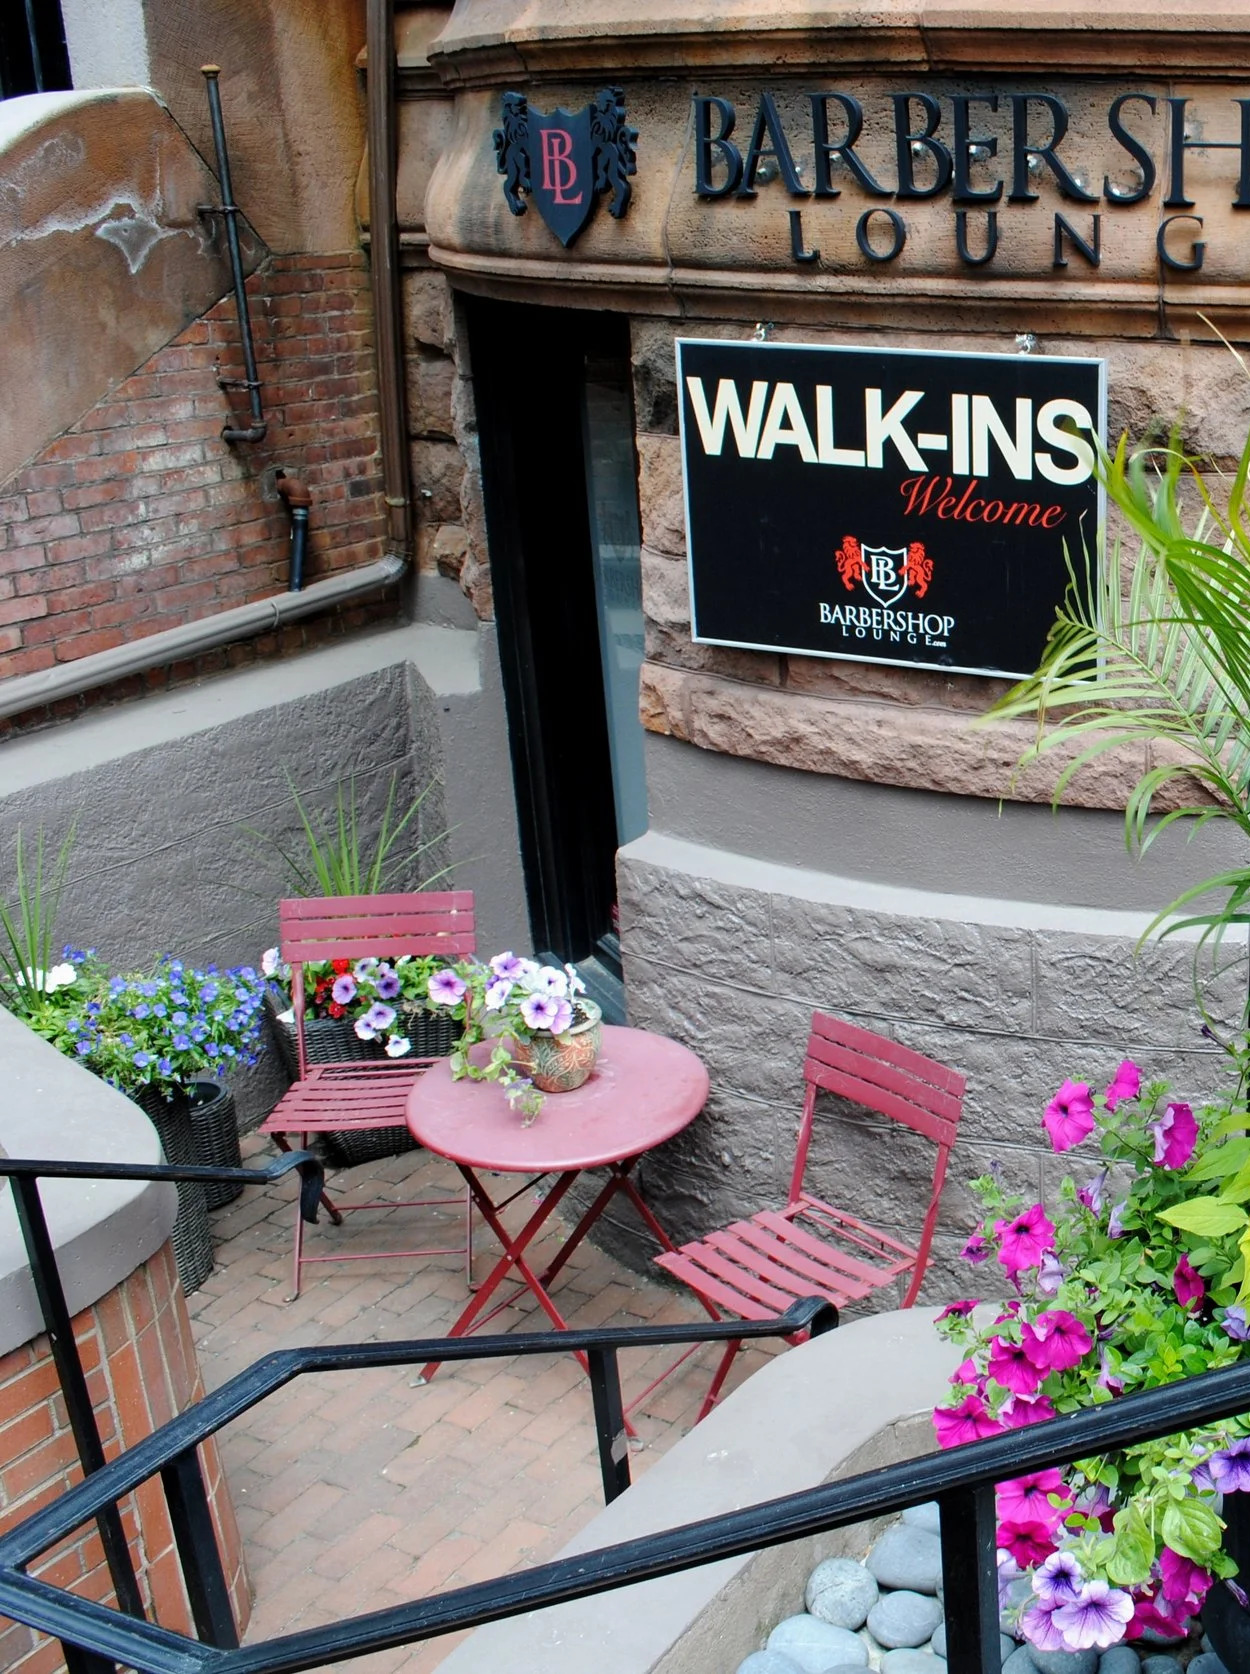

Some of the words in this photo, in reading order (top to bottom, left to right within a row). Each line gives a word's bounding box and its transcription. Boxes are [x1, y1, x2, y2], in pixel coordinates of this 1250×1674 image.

[539, 129, 582, 204] BL
[686, 376, 1095, 485] WALK-INS
[900, 475, 1066, 528] Welcome
[870, 555, 900, 591] BL
[819, 602, 955, 637] BARBERSHOP
